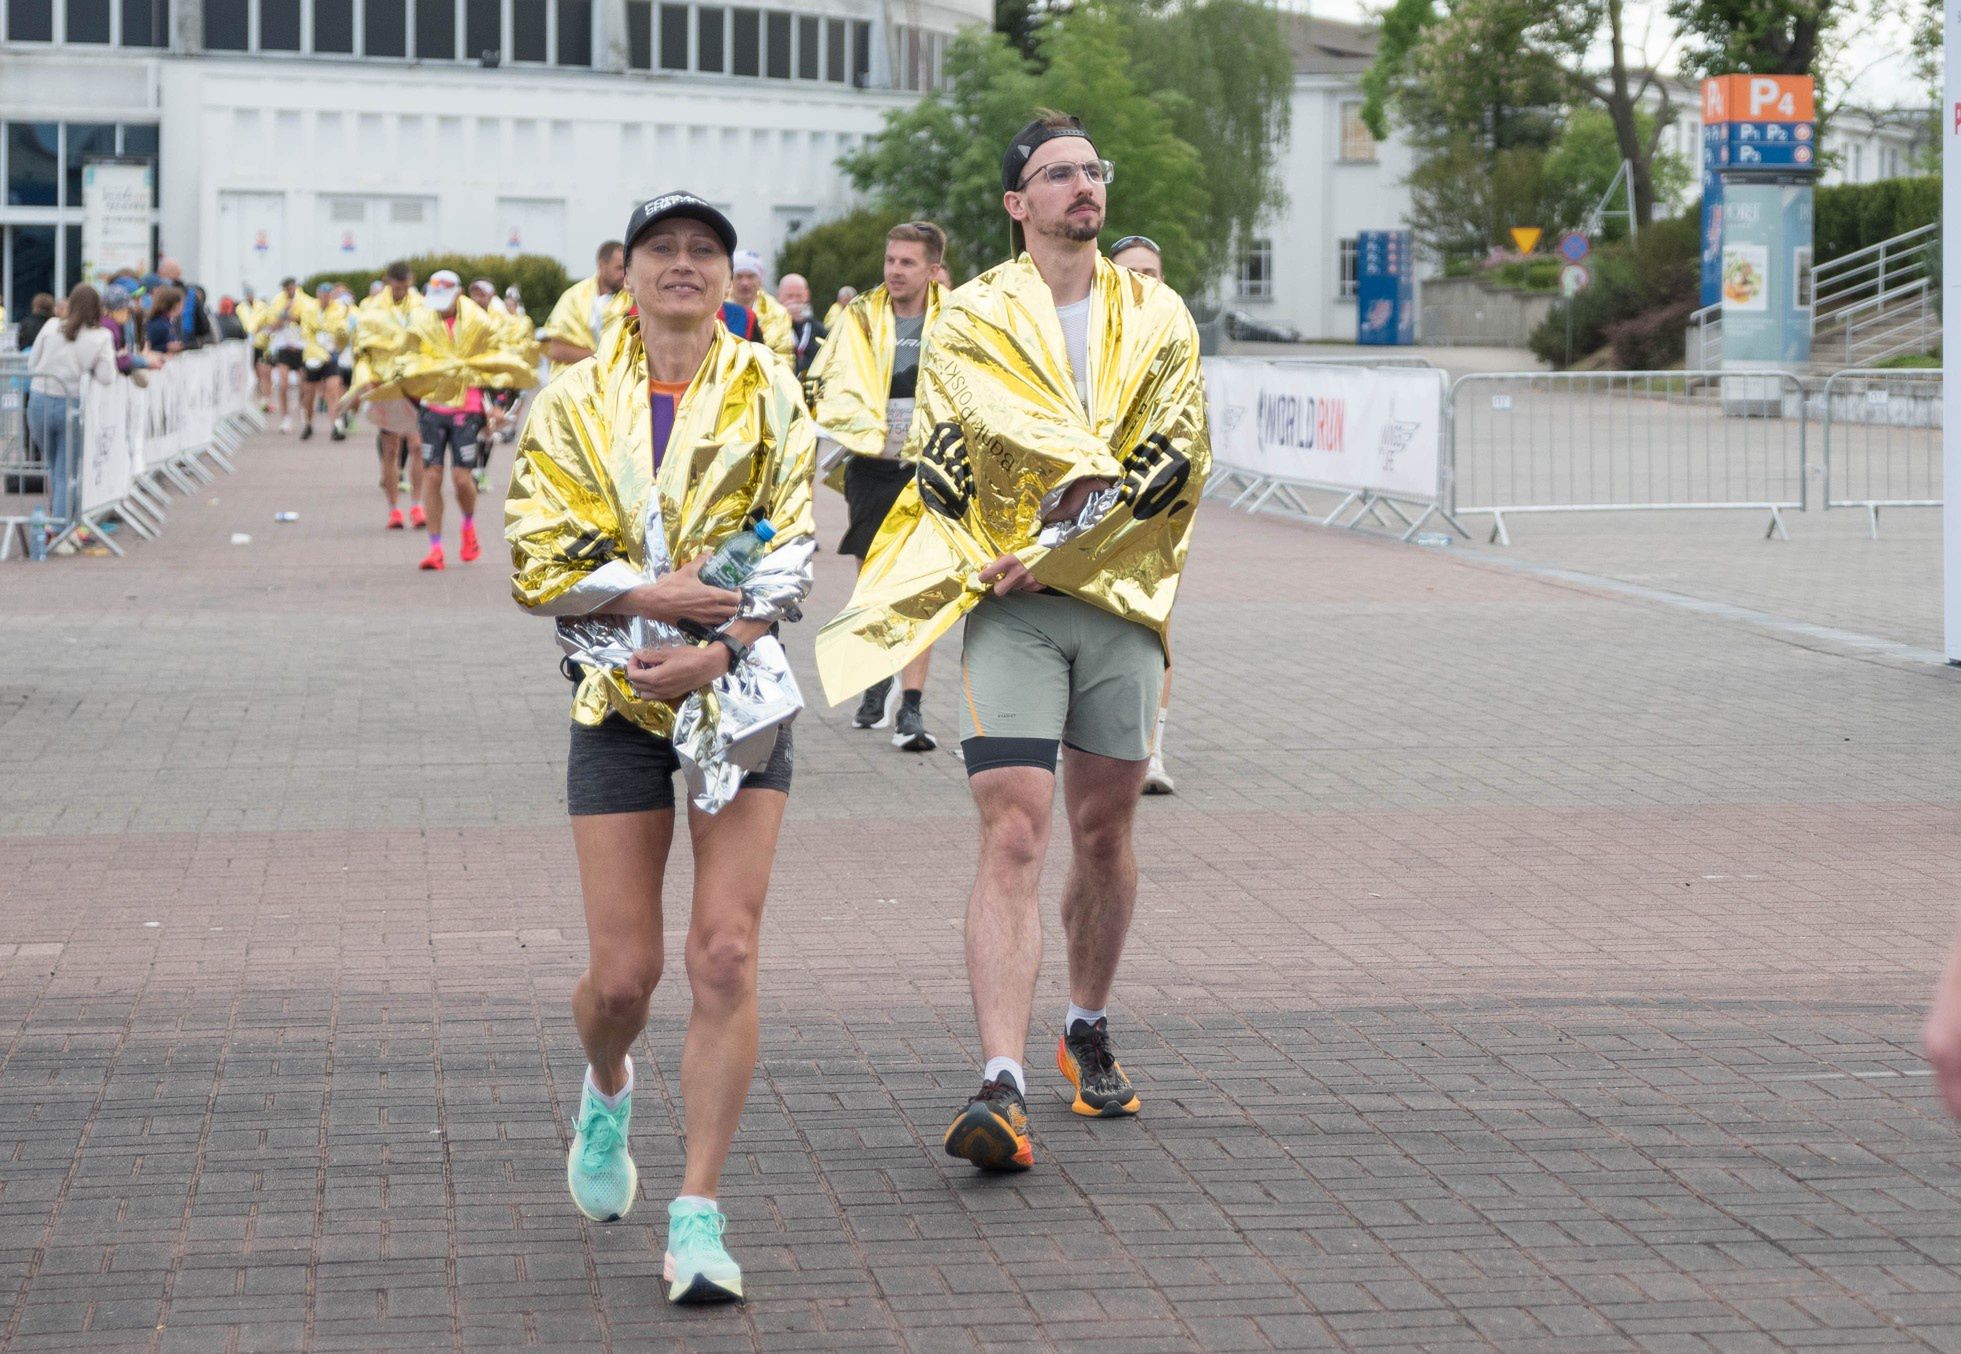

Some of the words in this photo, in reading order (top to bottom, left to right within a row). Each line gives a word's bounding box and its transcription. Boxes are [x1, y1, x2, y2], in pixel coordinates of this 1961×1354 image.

[1750, 77, 1795, 117] P4
[1766, 123, 1788, 141] P2
[941, 360, 974, 422] Polski
[972, 422, 1016, 474] Bank
[1265, 393, 1316, 449] WORLD
[1317, 397, 1345, 451] RUN
